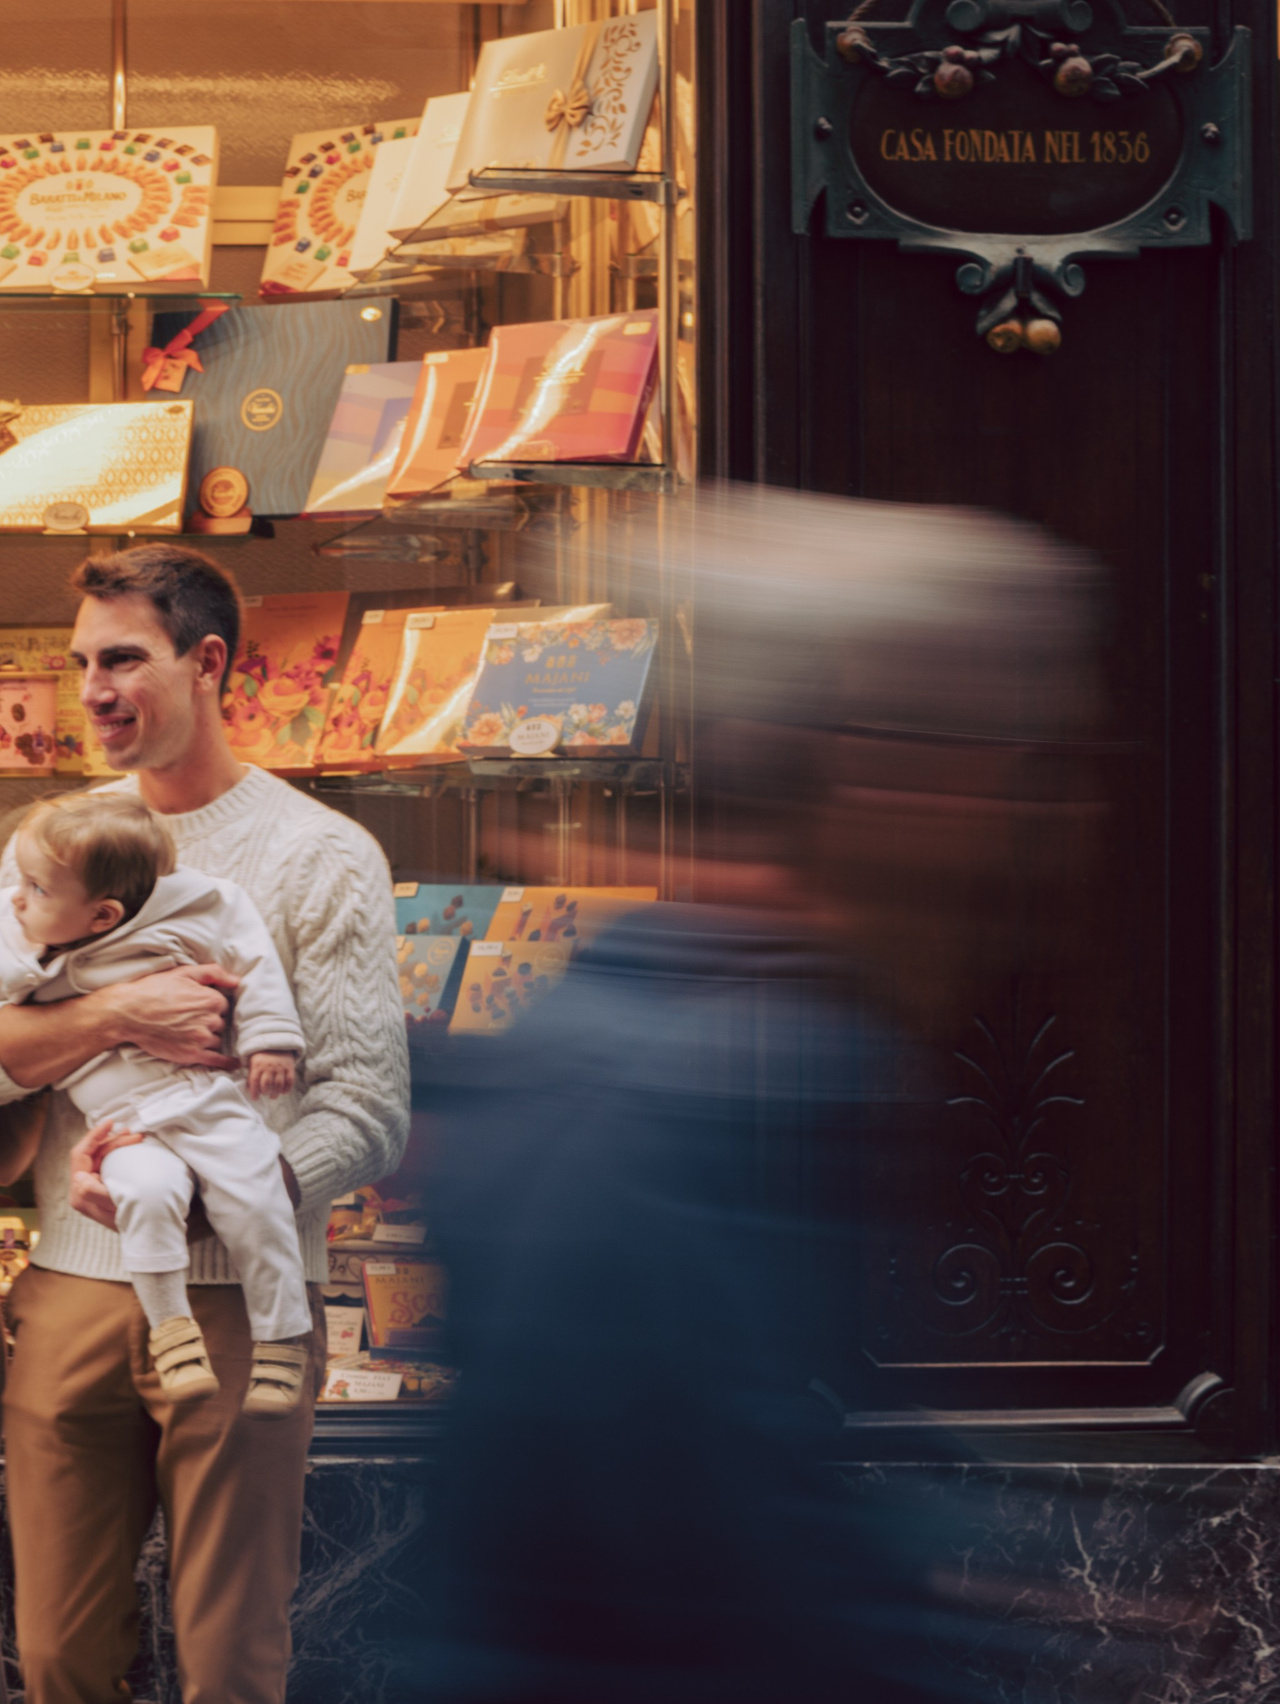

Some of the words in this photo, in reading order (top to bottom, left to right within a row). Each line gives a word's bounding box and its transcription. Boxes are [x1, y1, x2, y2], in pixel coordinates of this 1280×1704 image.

[880, 128, 938, 162] CASA
[943, 129, 1037, 163] FONDATA
[1044, 130, 1086, 163] NEL
[1090, 130, 1151, 163] 1836
[524, 671, 591, 686] MAJANI
[388, 1291, 439, 1325] Sco
